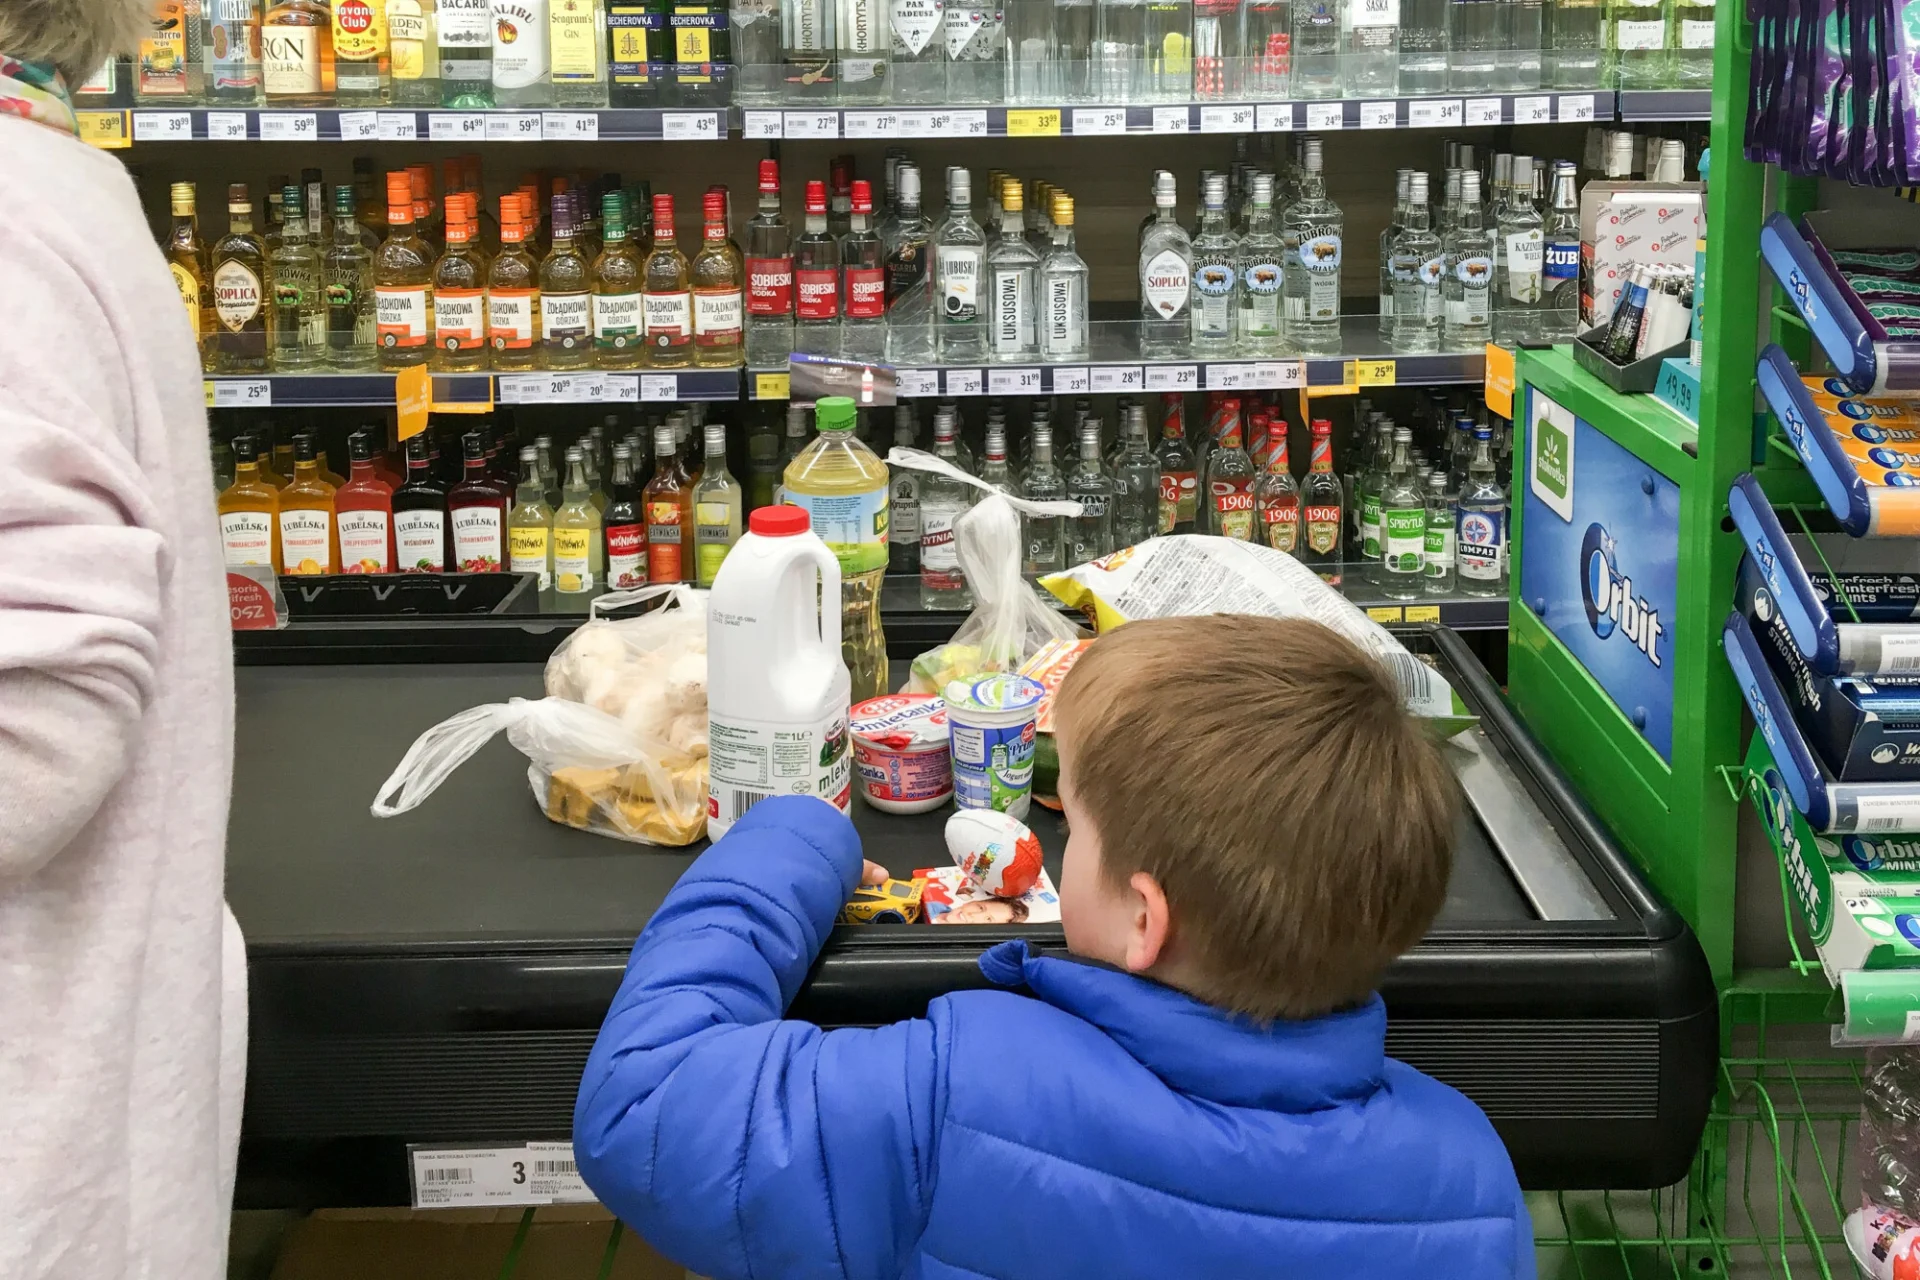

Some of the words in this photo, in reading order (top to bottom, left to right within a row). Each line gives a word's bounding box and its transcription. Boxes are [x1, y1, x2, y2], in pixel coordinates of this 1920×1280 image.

[335, 5, 375, 16] Havana
[341, 16, 367, 28] Club
[551, 13, 593, 26] Seagram's
[608, 15, 652, 26] BECHEROVKA
[671, 15, 715, 26] BECHEROVKA
[564, 29, 579, 38] GIN
[352, 38, 360, 47] 3
[1232, 111, 1252, 123] 3699
[1441, 105, 1460, 118] 3499
[1483, 110, 1500, 121] 2699
[1532, 108, 1550, 119] 2699
[1576, 106, 1592, 118] 2699
[99, 117, 120, 131] 5999
[169, 118, 189, 131] 3999
[294, 118, 314, 131] 5999
[463, 119, 483, 132] 6499
[519, 119, 539, 132] 5999
[576, 118, 595, 131] 4199
[817, 117, 837, 129] 2799
[877, 116, 896, 129] 2799
[931, 115, 950, 128] 3699
[1038, 115, 1057, 127] 3399
[1170, 119, 1187, 130] 2699
[1274, 117, 1290, 128] 2699
[1325, 116, 1341, 126] 2499
[1378, 114, 1394, 125] 2599
[227, 124, 244, 136] 3999
[359, 124, 376, 135] 5699
[396, 126, 413, 136] 2799
[763, 124, 780, 134] 3999
[969, 122, 986, 132] 2699
[555, 229, 574, 238] 1822
[607, 230, 625, 238] 1822
[655, 228, 674, 237] 1822
[708, 228, 725, 237] 1822
[1546, 246, 1579, 265] ŻUB
[945, 261, 976, 276] LUBUSKI
[1312, 263, 1338, 273] BIAŁA
[751, 272, 792, 287] SOBIESKI
[1148, 276, 1187, 289] SOPLICA
[214, 287, 257, 300] SOPLICA
[752, 289, 777, 297] VODKA
[800, 282, 835, 295] SOBIESKI
[1203, 286, 1227, 294] BIAŁA
[1254, 286, 1277, 294] BIAŁA
[1001, 277, 1016, 341] LUKSUSOWA
[1052, 282, 1067, 340] LUKSUSOWA
[556, 315, 580, 326] GORZKA
[608, 315, 631, 326] GORZKA
[652, 314, 674, 325] GORZKA
[1121, 371, 1141, 383] 2899
[1177, 370, 1195, 382] 2399
[1375, 365, 1394, 378] 2599
[1020, 373, 1040, 386] 3199
[1070, 378, 1086, 390] 2399
[1223, 376, 1238, 386] 2299
[248, 385, 268, 398] 2599
[551, 380, 570, 393] 2099
[620, 387, 636, 398] 2099
[659, 386, 675, 397] 2099
[920, 381, 936, 393] 2599
[964, 381, 980, 392] 2599
[1666, 371, 1692, 413] 19,99
[1837, 400, 1902, 421] Orbit
[1852, 423, 1919, 444] Orbit
[1537, 455, 1568, 488] stokrotka
[889, 499, 921, 511] Krupnik
[1220, 494, 1253, 512] 1906
[1269, 508, 1297, 523] 1906
[1307, 507, 1338, 522] 1906
[225, 521, 268, 534] LUBELSKA
[283, 520, 325, 532] LUBELSKA
[341, 521, 384, 533] LUBELSKA
[398, 520, 440, 533] LUBELSKA
[456, 516, 497, 530] LUBELSKA
[1389, 517, 1424, 530] SPIRYTUS
[1580, 521, 1662, 668] Orbit
[1768, 626, 1798, 672] STRONG
[1003, 768, 1024, 781] Jogurt
[512, 1161, 526, 1185] 3
